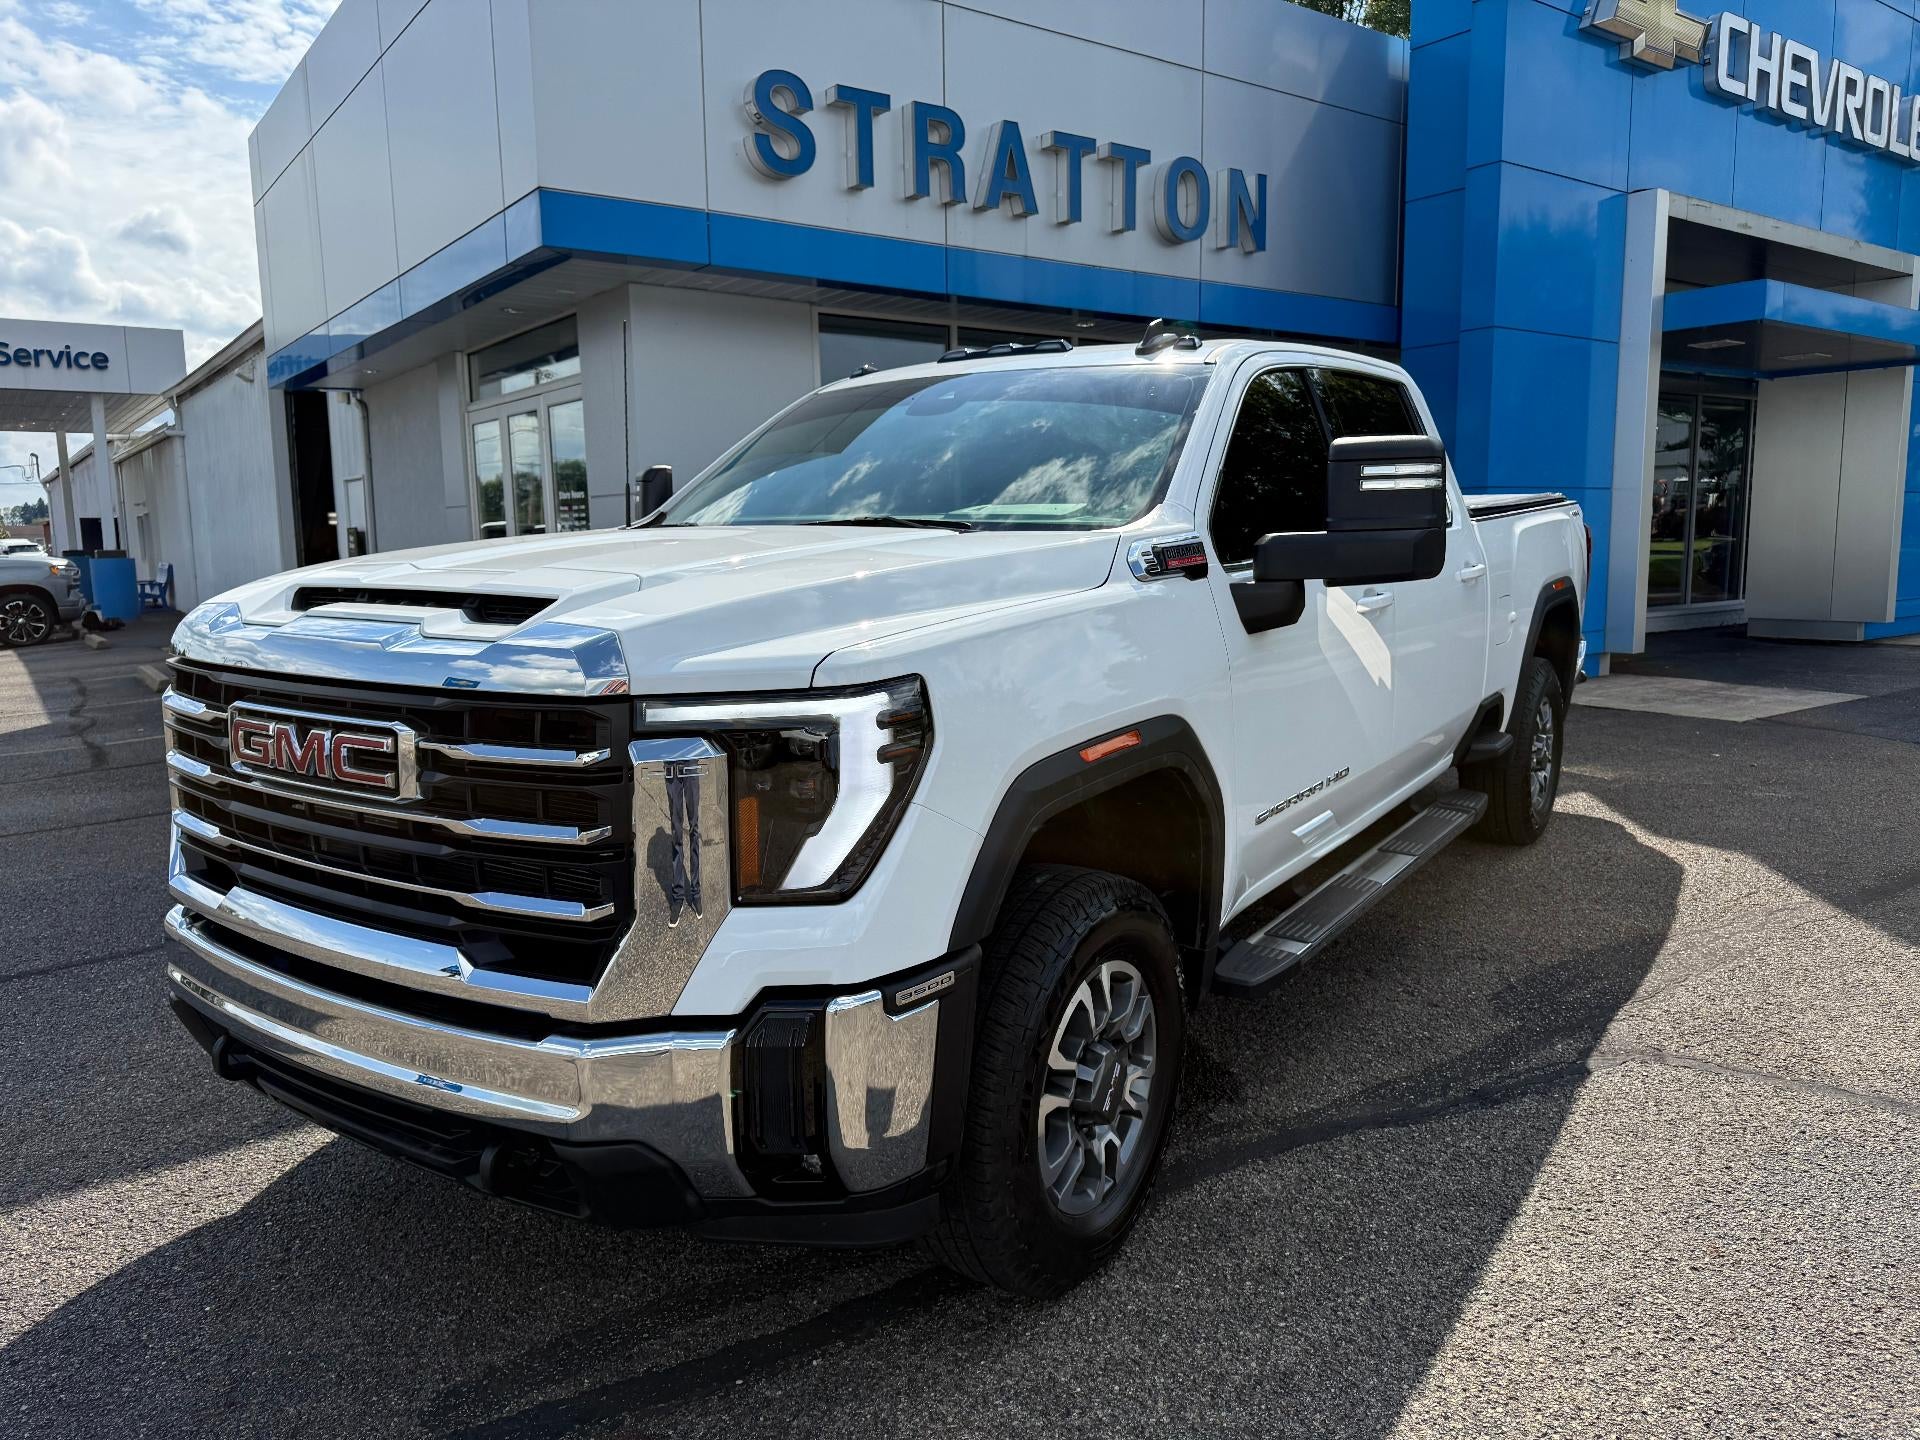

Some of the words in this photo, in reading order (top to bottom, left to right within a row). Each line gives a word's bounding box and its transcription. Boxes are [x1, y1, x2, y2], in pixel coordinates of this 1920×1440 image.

[744, 69, 1267, 253] STRATTON
[0, 341, 109, 371] Service
[1166, 544, 1202, 559] DURAMAX
[231, 716, 396, 790] GMC
[1254, 780, 1324, 826] SIERRA
[1325, 766, 1350, 788] HD
[899, 975, 952, 1001] 3500
